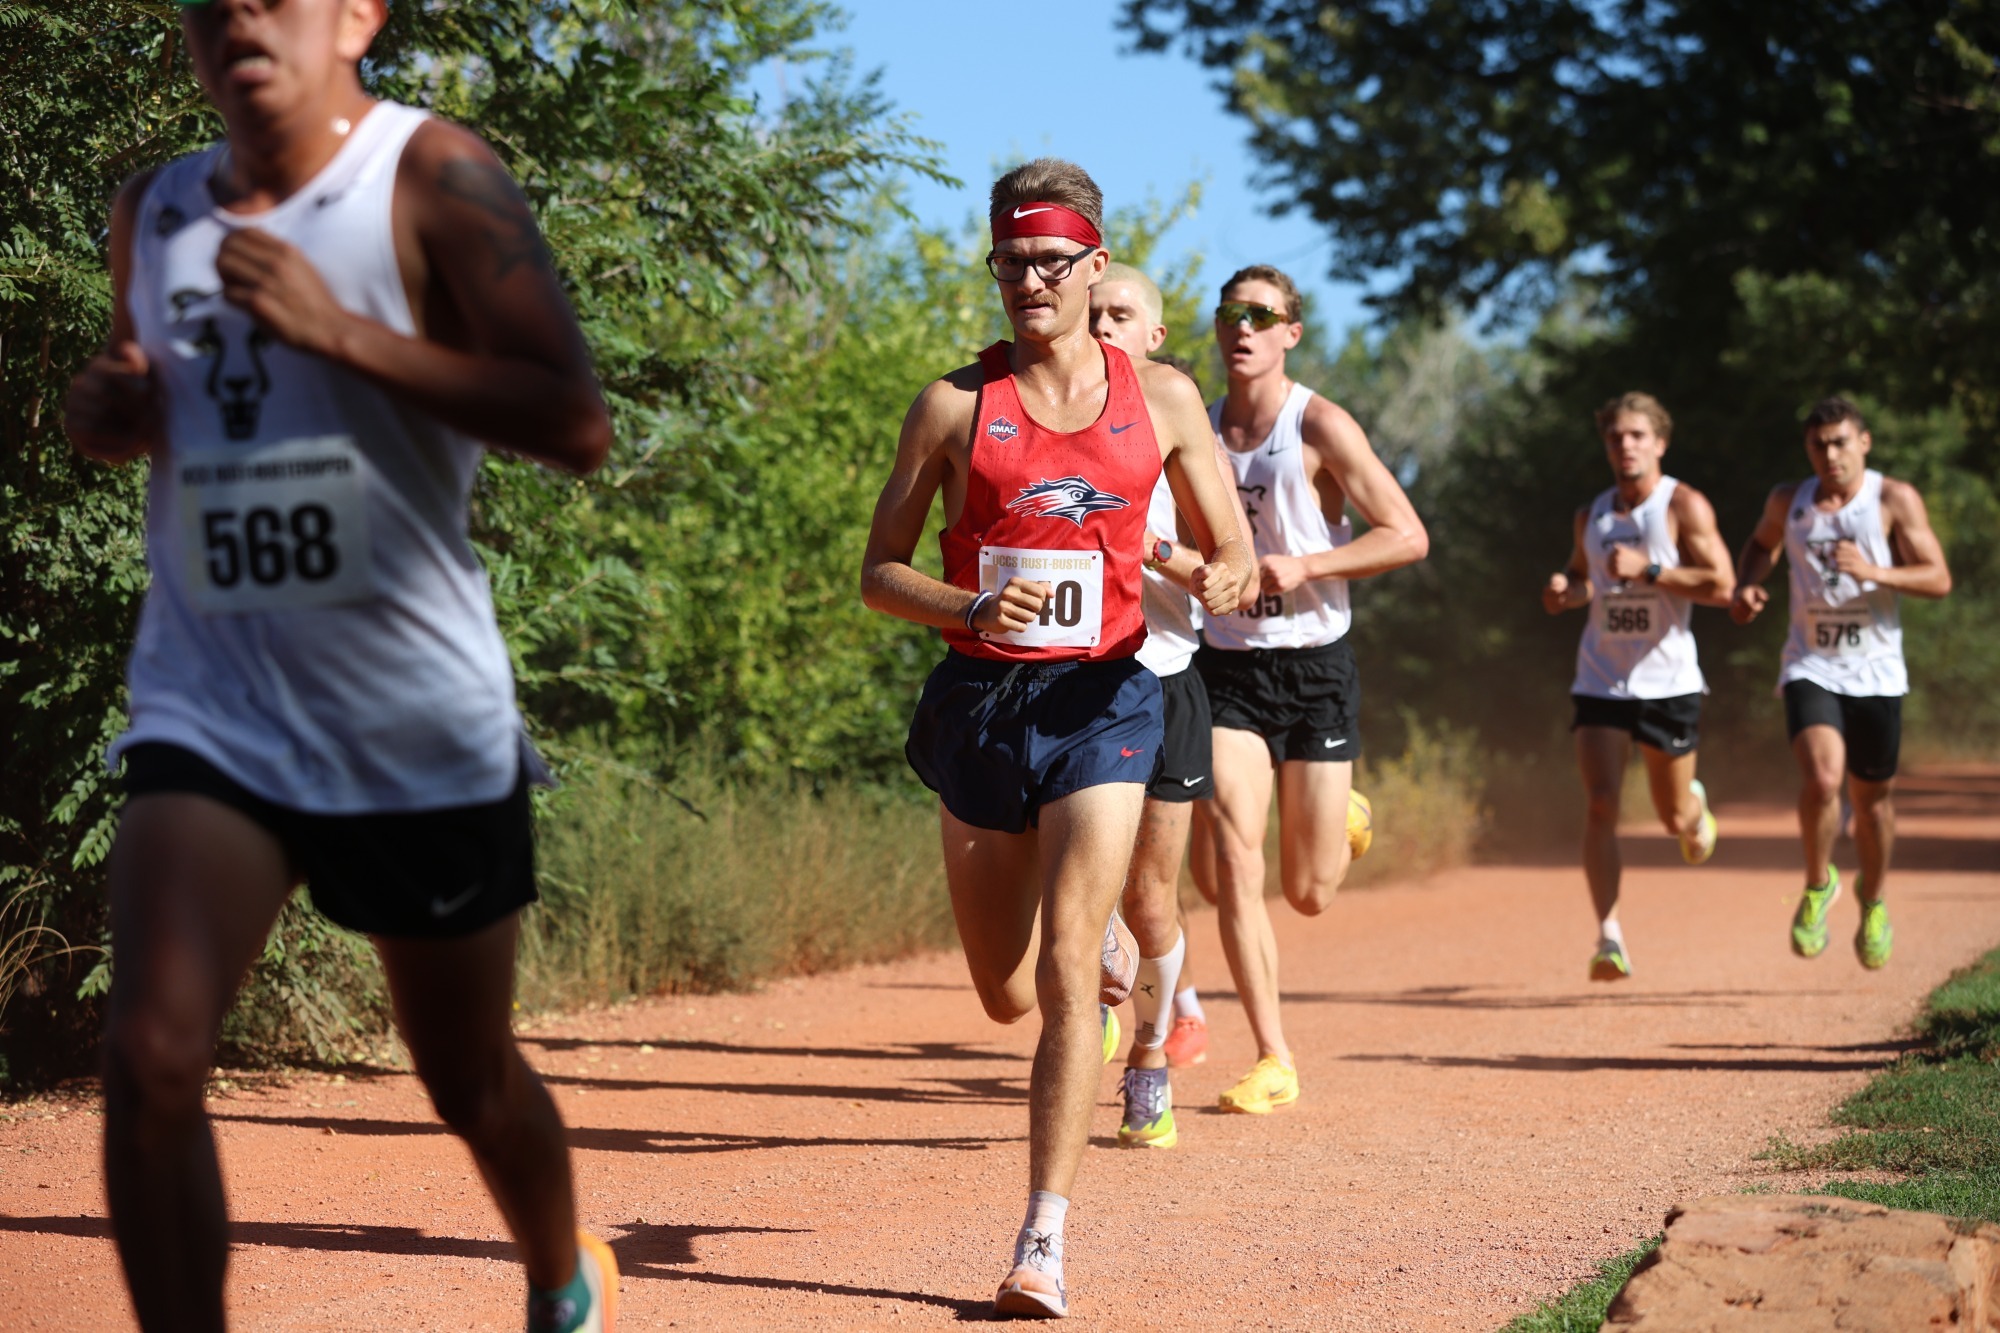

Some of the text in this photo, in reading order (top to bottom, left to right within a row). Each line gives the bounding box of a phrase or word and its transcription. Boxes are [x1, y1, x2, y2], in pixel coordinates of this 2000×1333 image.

[989, 425, 1017, 434] RMAC
[203, 503, 340, 589] 568
[992, 554, 1092, 570] UCCS RUST-BUSTER
[1816, 622, 1860, 648] 576
